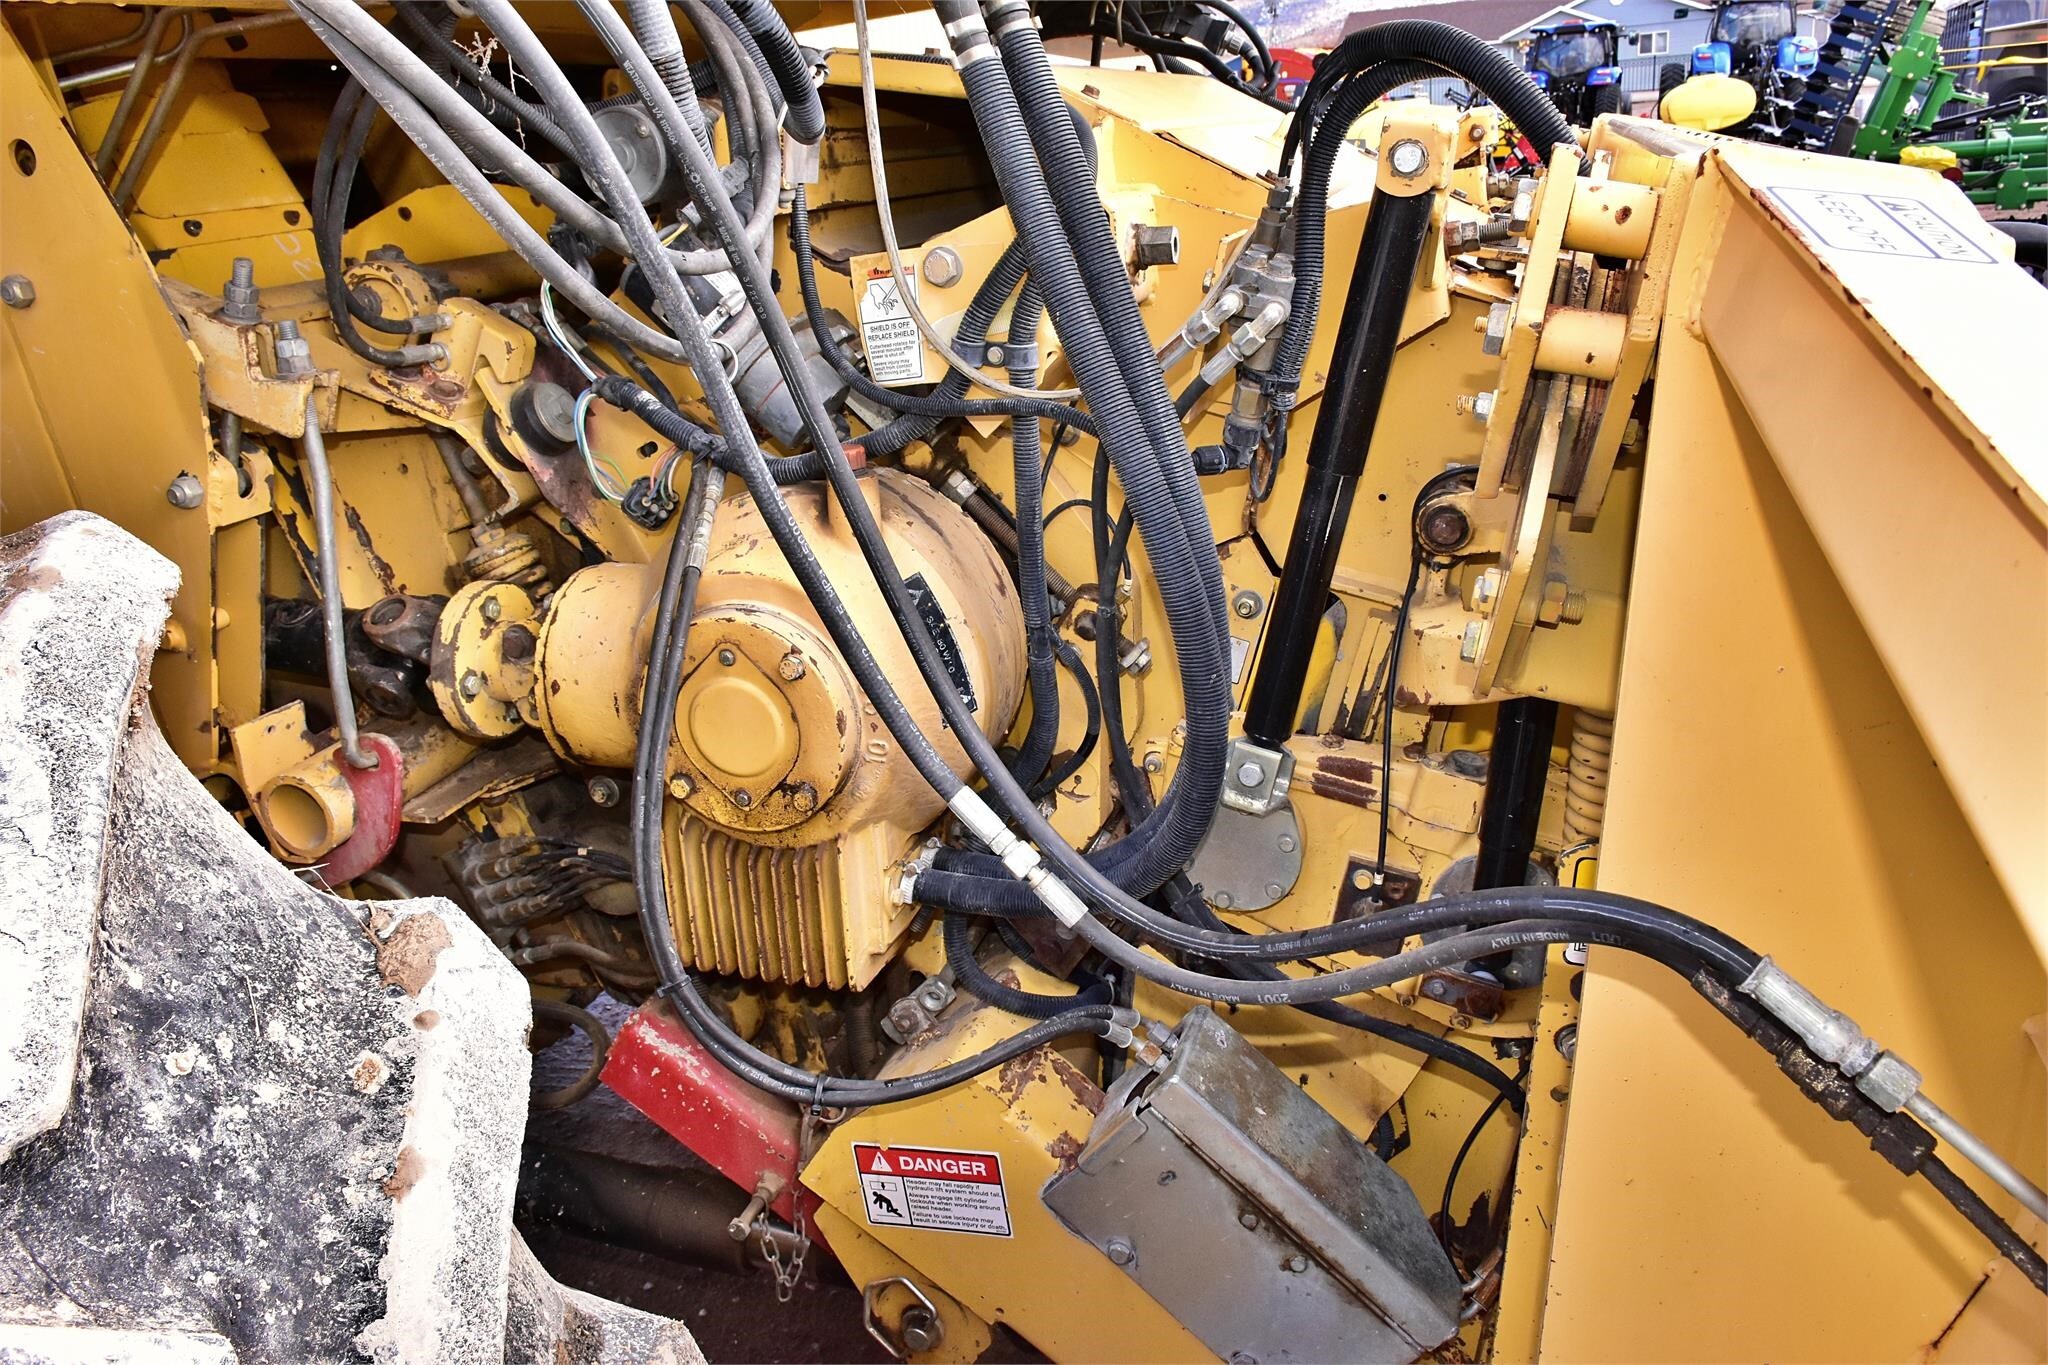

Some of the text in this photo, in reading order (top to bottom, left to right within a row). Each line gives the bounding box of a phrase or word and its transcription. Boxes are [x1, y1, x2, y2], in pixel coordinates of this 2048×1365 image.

[870, 324, 890, 333] SHIELD
[897, 321, 911, 329] OFF
[868, 329, 915, 341] REPLACE SHIELD
[926, 615, 940, 637] SE
[1491, 934, 1521, 949] ITALY
[1256, 993, 1291, 1004] 2001
[898, 1155, 988, 1177] DANGER
